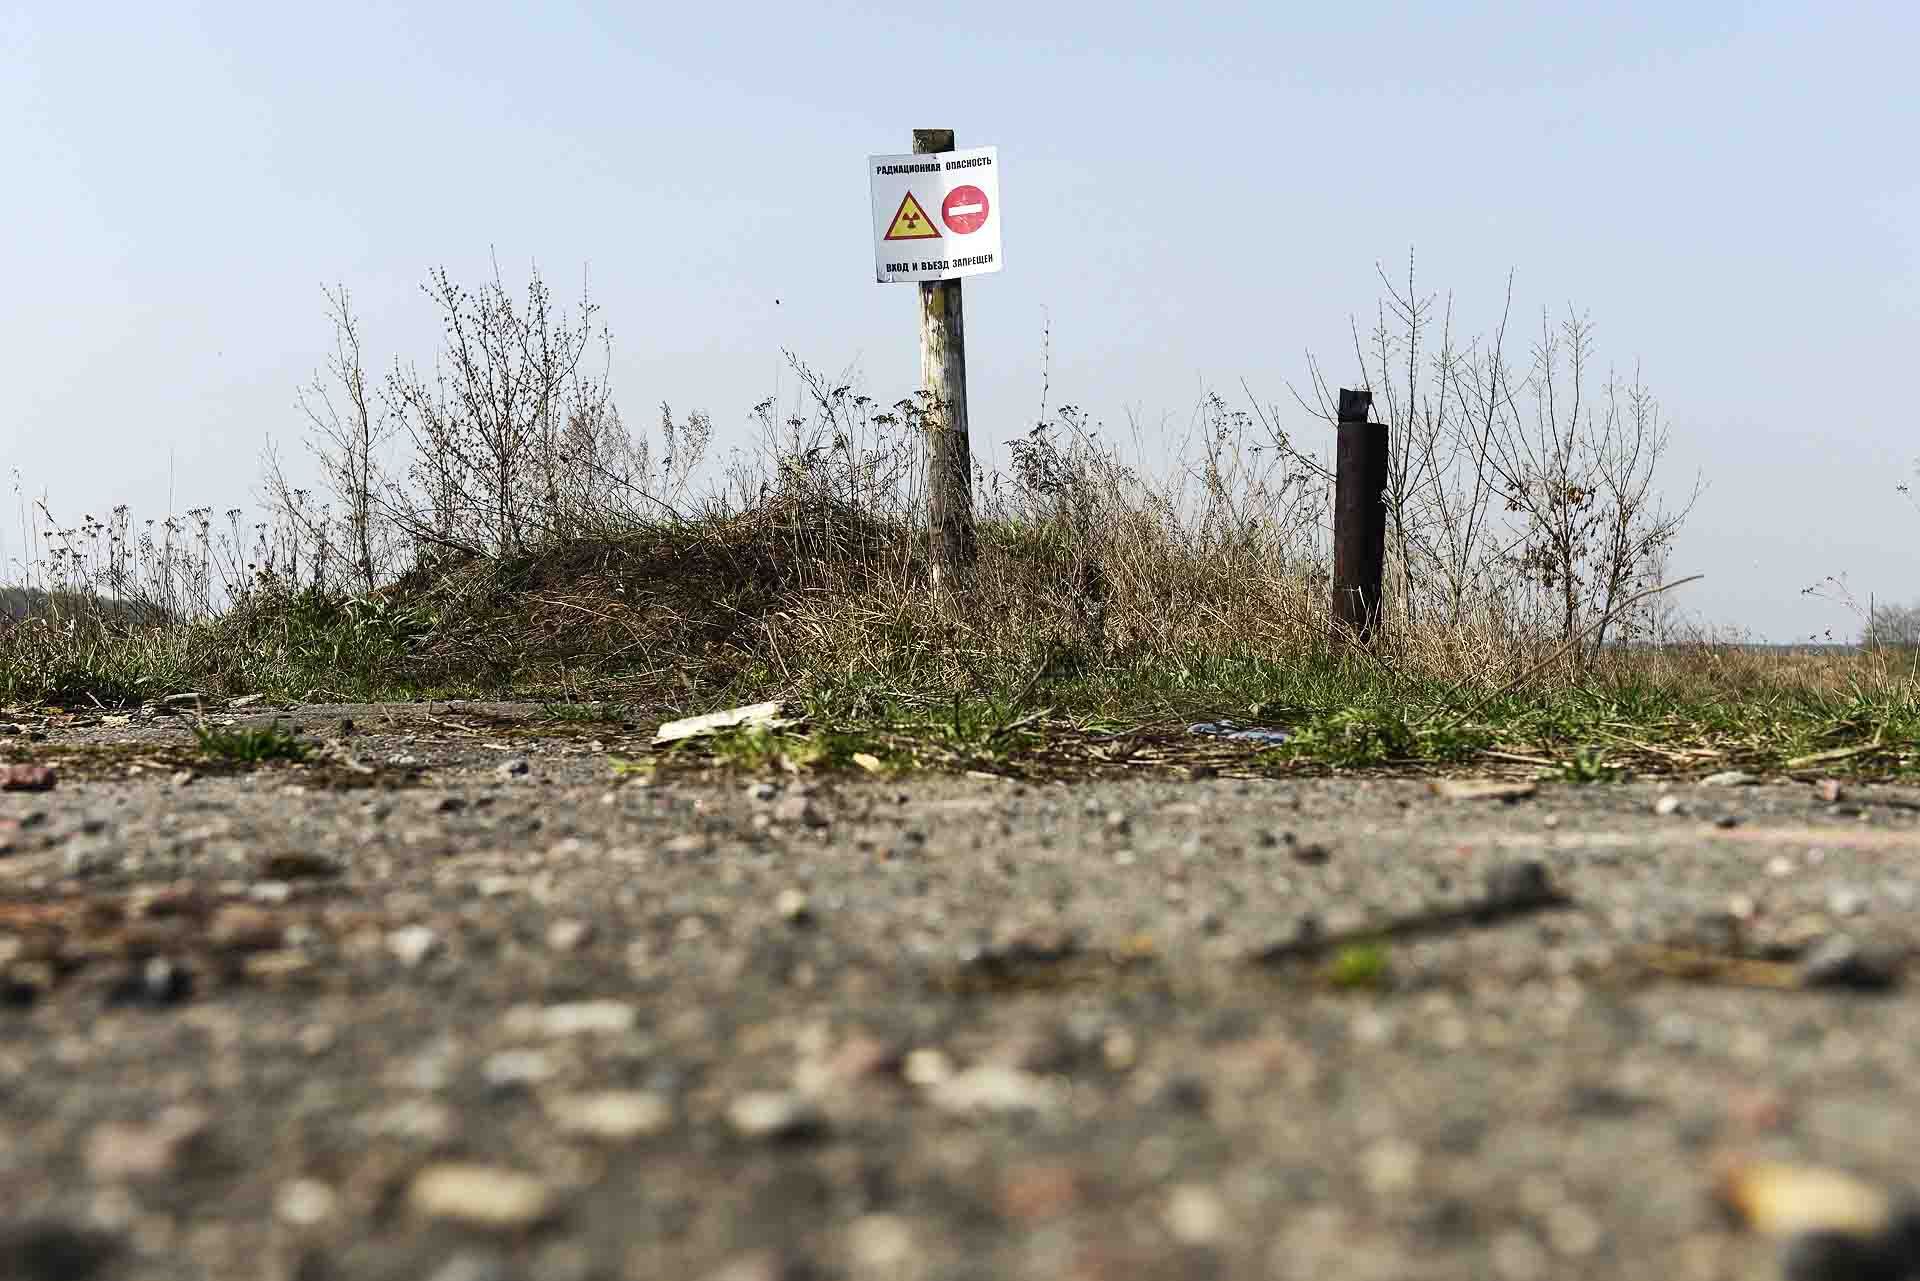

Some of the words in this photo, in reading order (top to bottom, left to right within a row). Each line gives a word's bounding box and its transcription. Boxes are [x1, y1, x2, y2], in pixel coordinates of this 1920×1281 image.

[876, 163, 941, 175] РАДИАЦИОННАЯ
[945, 156, 992, 171] ОПАСНОСТЬ
[886, 262, 910, 273] ВХОД
[912, 262, 918, 271] И
[921, 260, 949, 271] ВЪЕЗД
[952, 253, 993, 268] ЗАПРЕЩЕН
